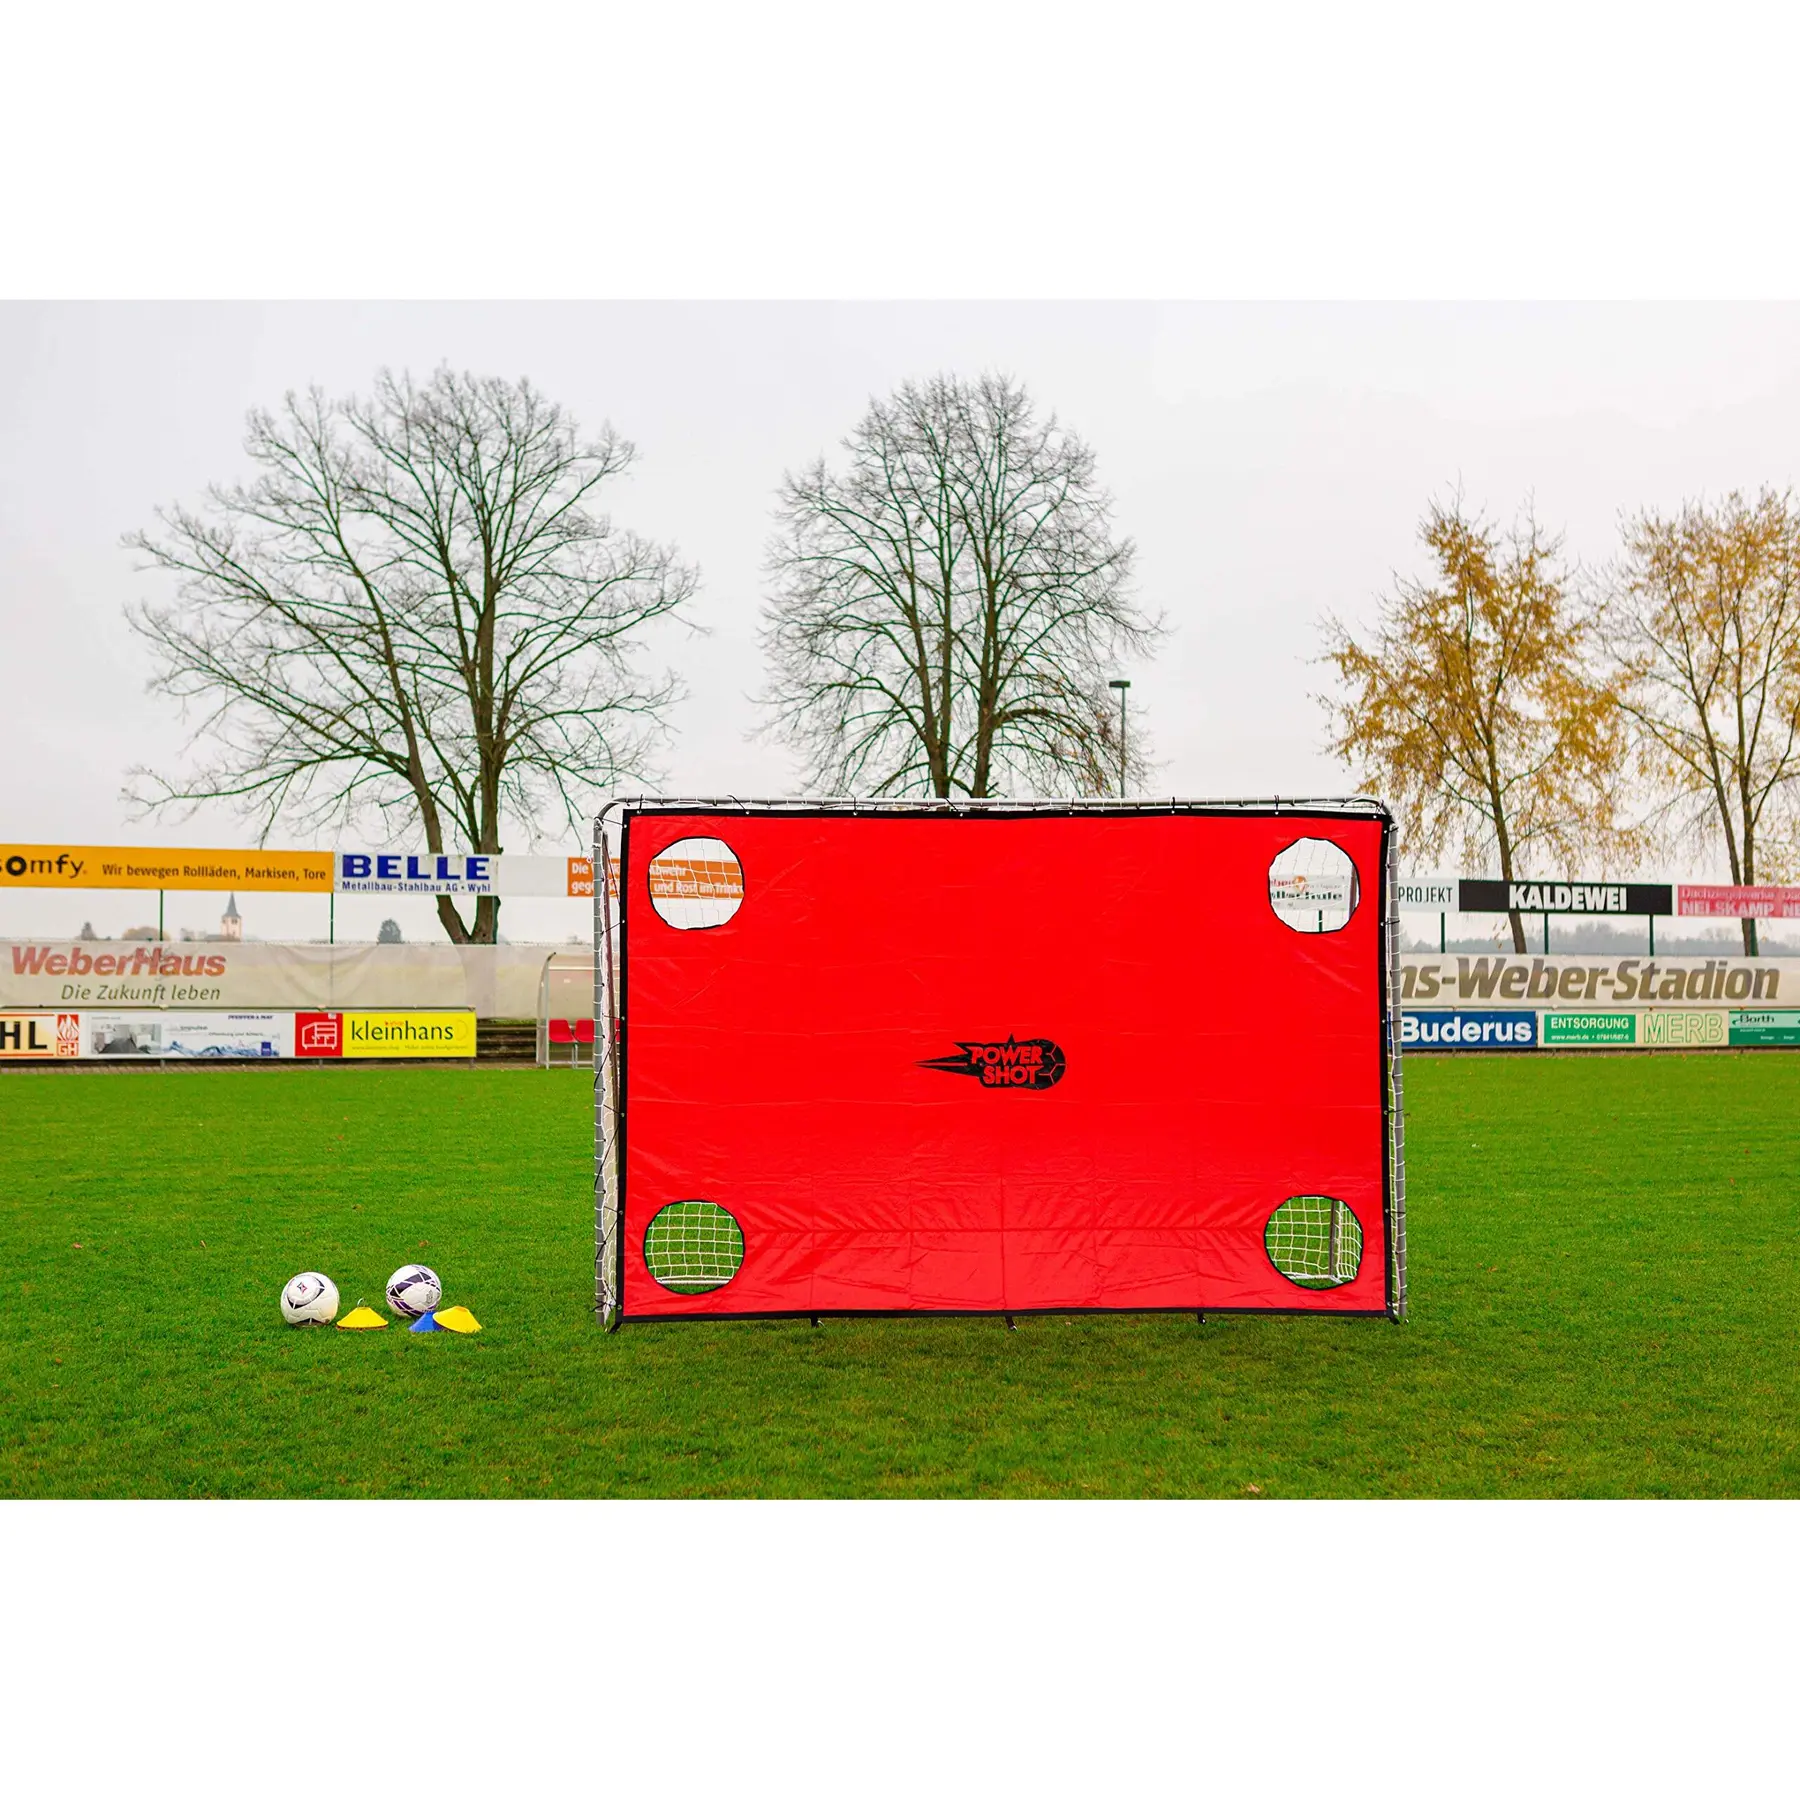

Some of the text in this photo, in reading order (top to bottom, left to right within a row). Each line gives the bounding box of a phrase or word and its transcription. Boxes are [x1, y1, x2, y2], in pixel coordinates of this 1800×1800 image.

[0, 854, 84, 879] omfy
[102, 864, 326, 881] Wir bewegen Rollläden, Markisen, Tore
[342, 854, 490, 881] BELLE
[572, 862, 589, 875] Die
[342, 881, 491, 894] Metallbau-Stahlbau AG Wyhl
[1398, 886, 1453, 903] PROJEKT
[1509, 884, 1628, 912] KALDEWEI
[1682, 900, 1775, 917] NELSKAMP
[12, 946, 226, 977] WeberHaus
[61, 984, 220, 1003] Die Zukunft leben
[352, 1020, 454, 1040] kleinhans
[1400, 1016, 1532, 1042] Buderus
[1551, 1017, 1629, 1029] ENTSORGUNG
[1643, 1013, 1724, 1044] MERB
[965, 1045, 1043, 1064] POWER
[983, 1065, 1044, 1085] SHOT
